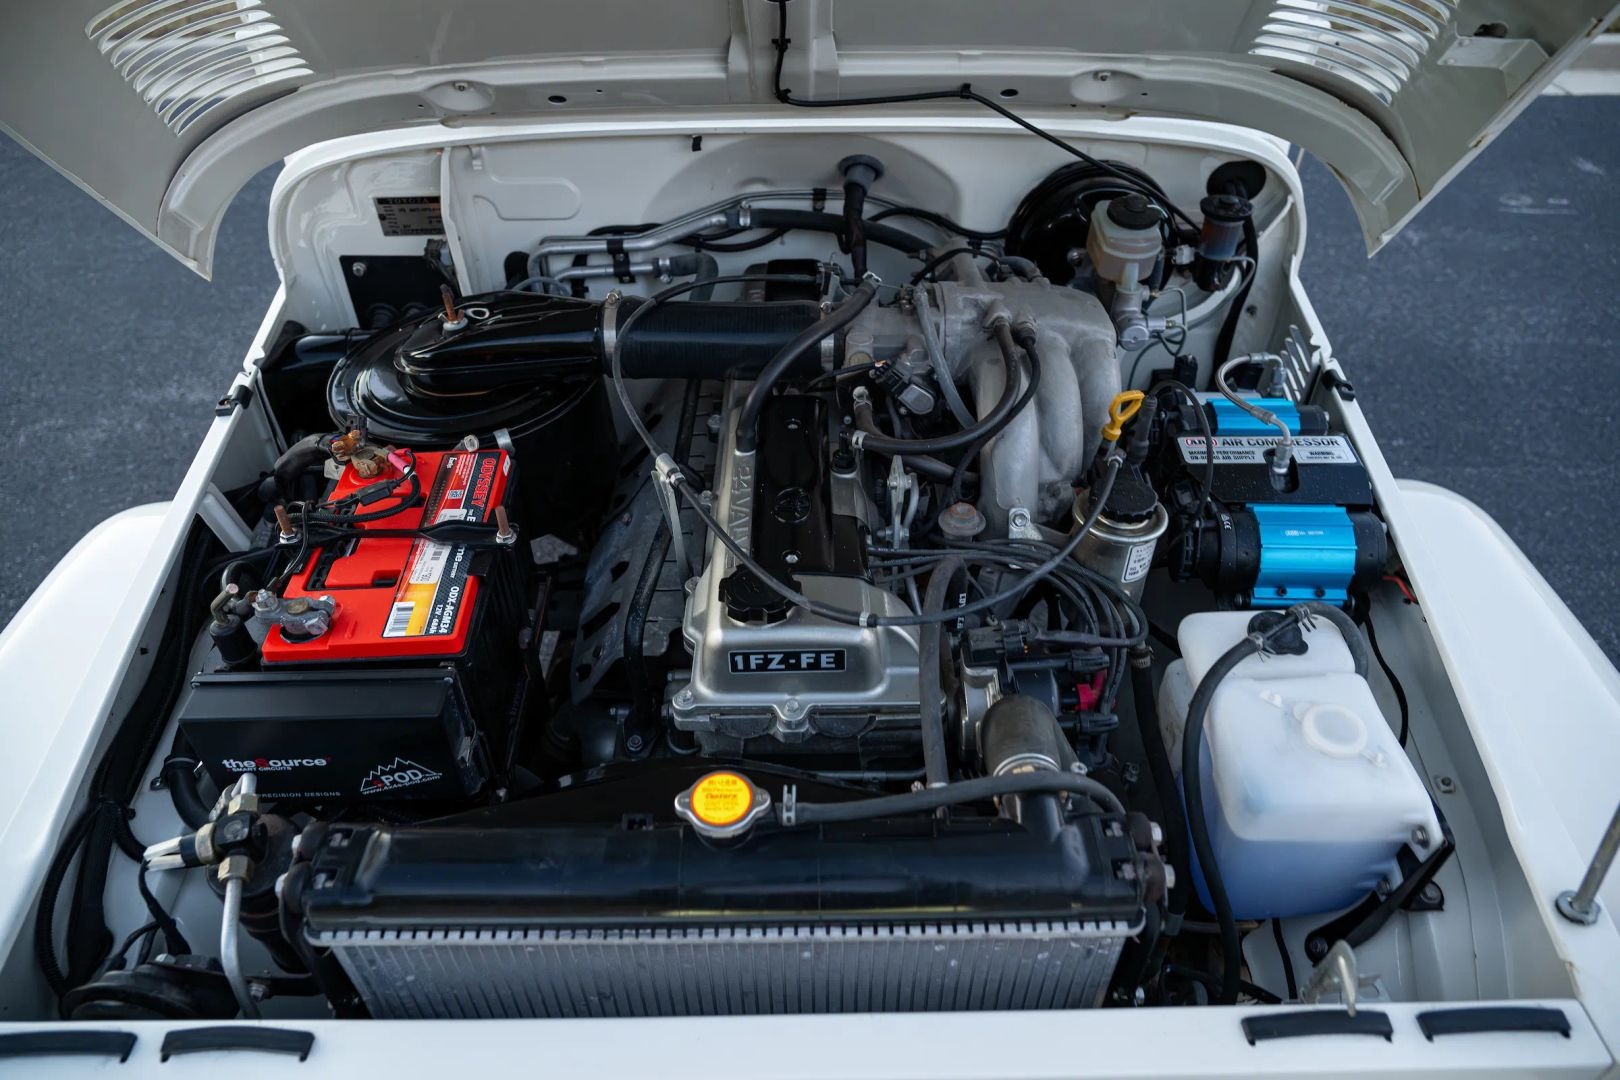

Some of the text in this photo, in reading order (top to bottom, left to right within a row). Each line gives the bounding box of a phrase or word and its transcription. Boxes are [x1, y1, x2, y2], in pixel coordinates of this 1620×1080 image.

[1222, 438, 1244, 446] AIR
[471, 457, 496, 508] ODYSSEY
[435, 604, 444, 616] 12V
[439, 585, 460, 634] ODX-AGM34
[429, 618, 439, 634] 68Ah
[734, 653, 836, 670] 1FZ-FE
[221, 757, 328, 769] theSource
